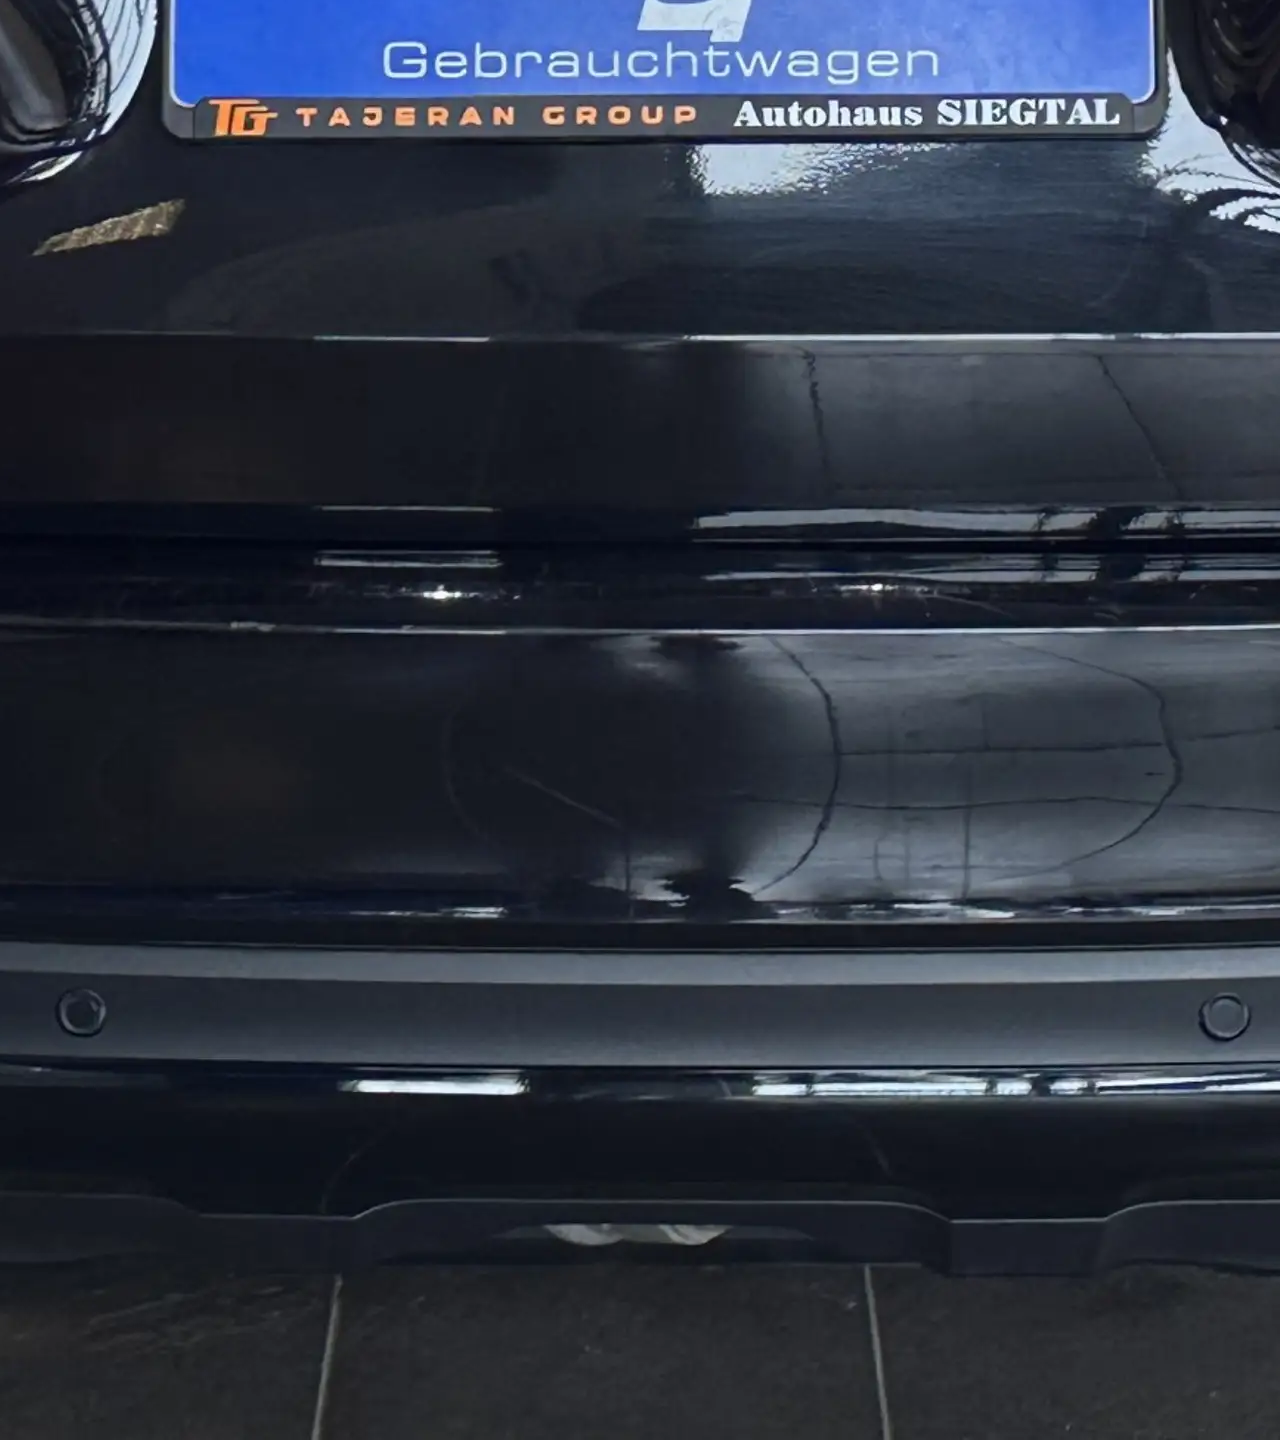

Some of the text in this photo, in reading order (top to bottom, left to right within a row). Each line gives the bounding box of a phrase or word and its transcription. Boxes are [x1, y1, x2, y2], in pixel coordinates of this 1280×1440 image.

[382, 41, 940, 85] Gebrauchtwagen
[295, 106, 516, 127] TAJERAN
[542, 105, 698, 126] GROUP
[733, 100, 923, 127] Autohaus
[936, 98, 1121, 127] SIEGTAL
